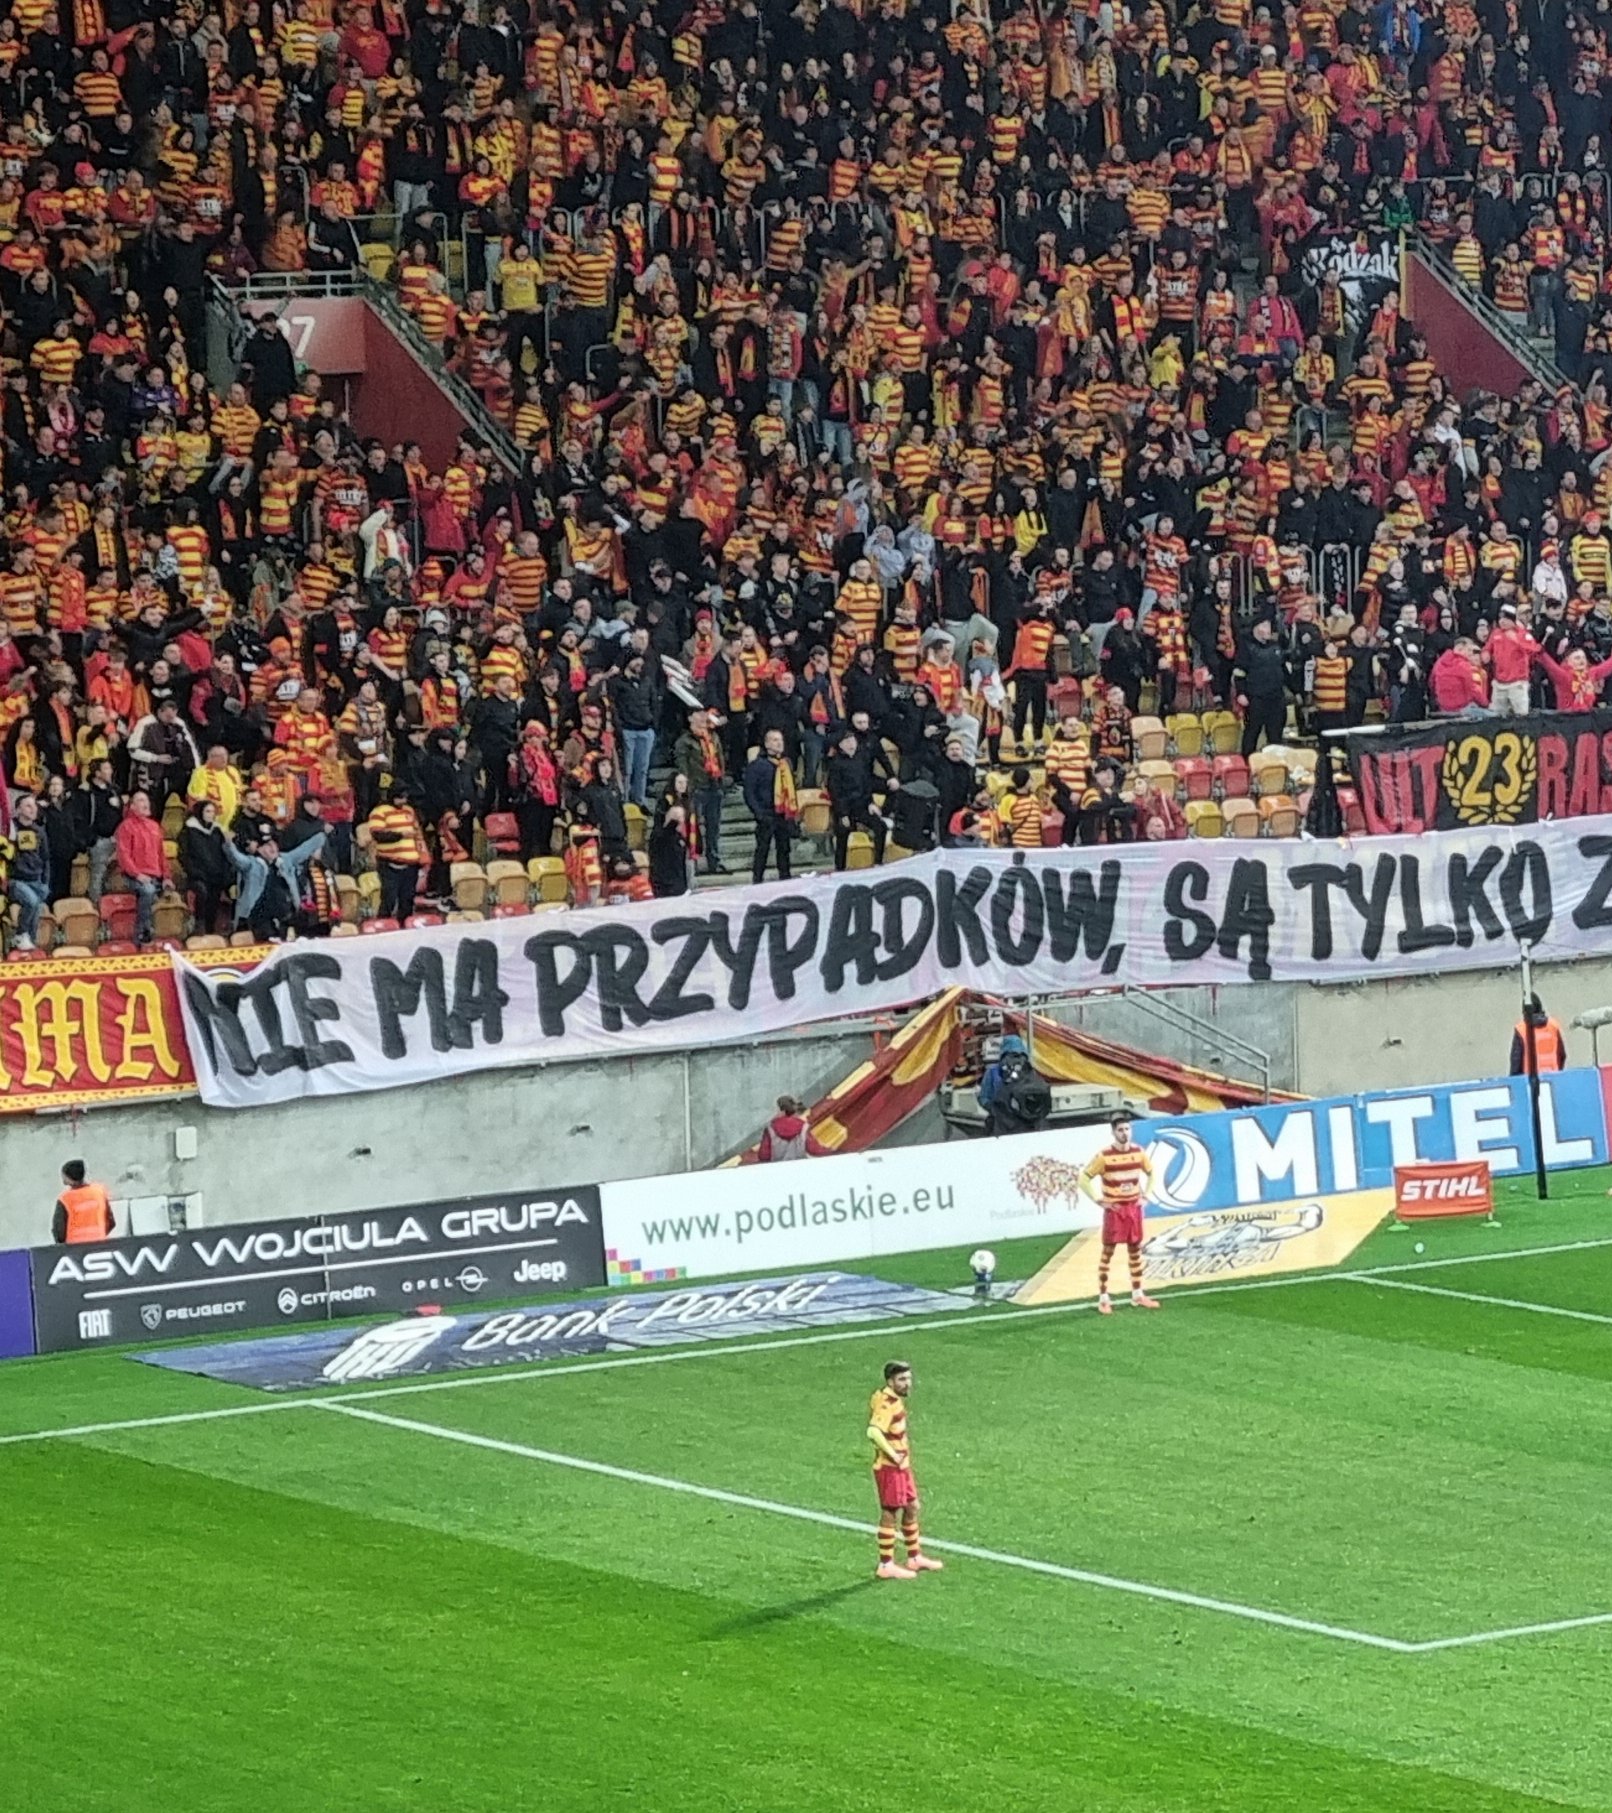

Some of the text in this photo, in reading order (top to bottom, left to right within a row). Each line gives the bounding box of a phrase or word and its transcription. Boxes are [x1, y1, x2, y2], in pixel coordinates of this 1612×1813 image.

[276, 315, 315, 358] 7
[1458, 732, 1522, 806] 23
[183, 952, 354, 1077] NIE
[370, 938, 509, 1060] MA
[1163, 857, 1275, 980] SĄ
[1287, 840, 1553, 960] TYLKO
[0, 977, 180, 1090] MA
[1230, 1083, 1594, 1203] MITEL
[641, 1184, 955, 1245] www.podlaskie.eu
[1400, 1175, 1486, 1202] STIHL
[48, 1199, 588, 1285] ASW WOJCIULA GRUPA
[78, 1308, 111, 1340] FIAT
[165, 1300, 246, 1321] PEUGEOT
[402, 1278, 454, 1293] OPEL
[514, 1259, 567, 1283] Jeep
[461, 1276, 842, 1352] Bank Polski
